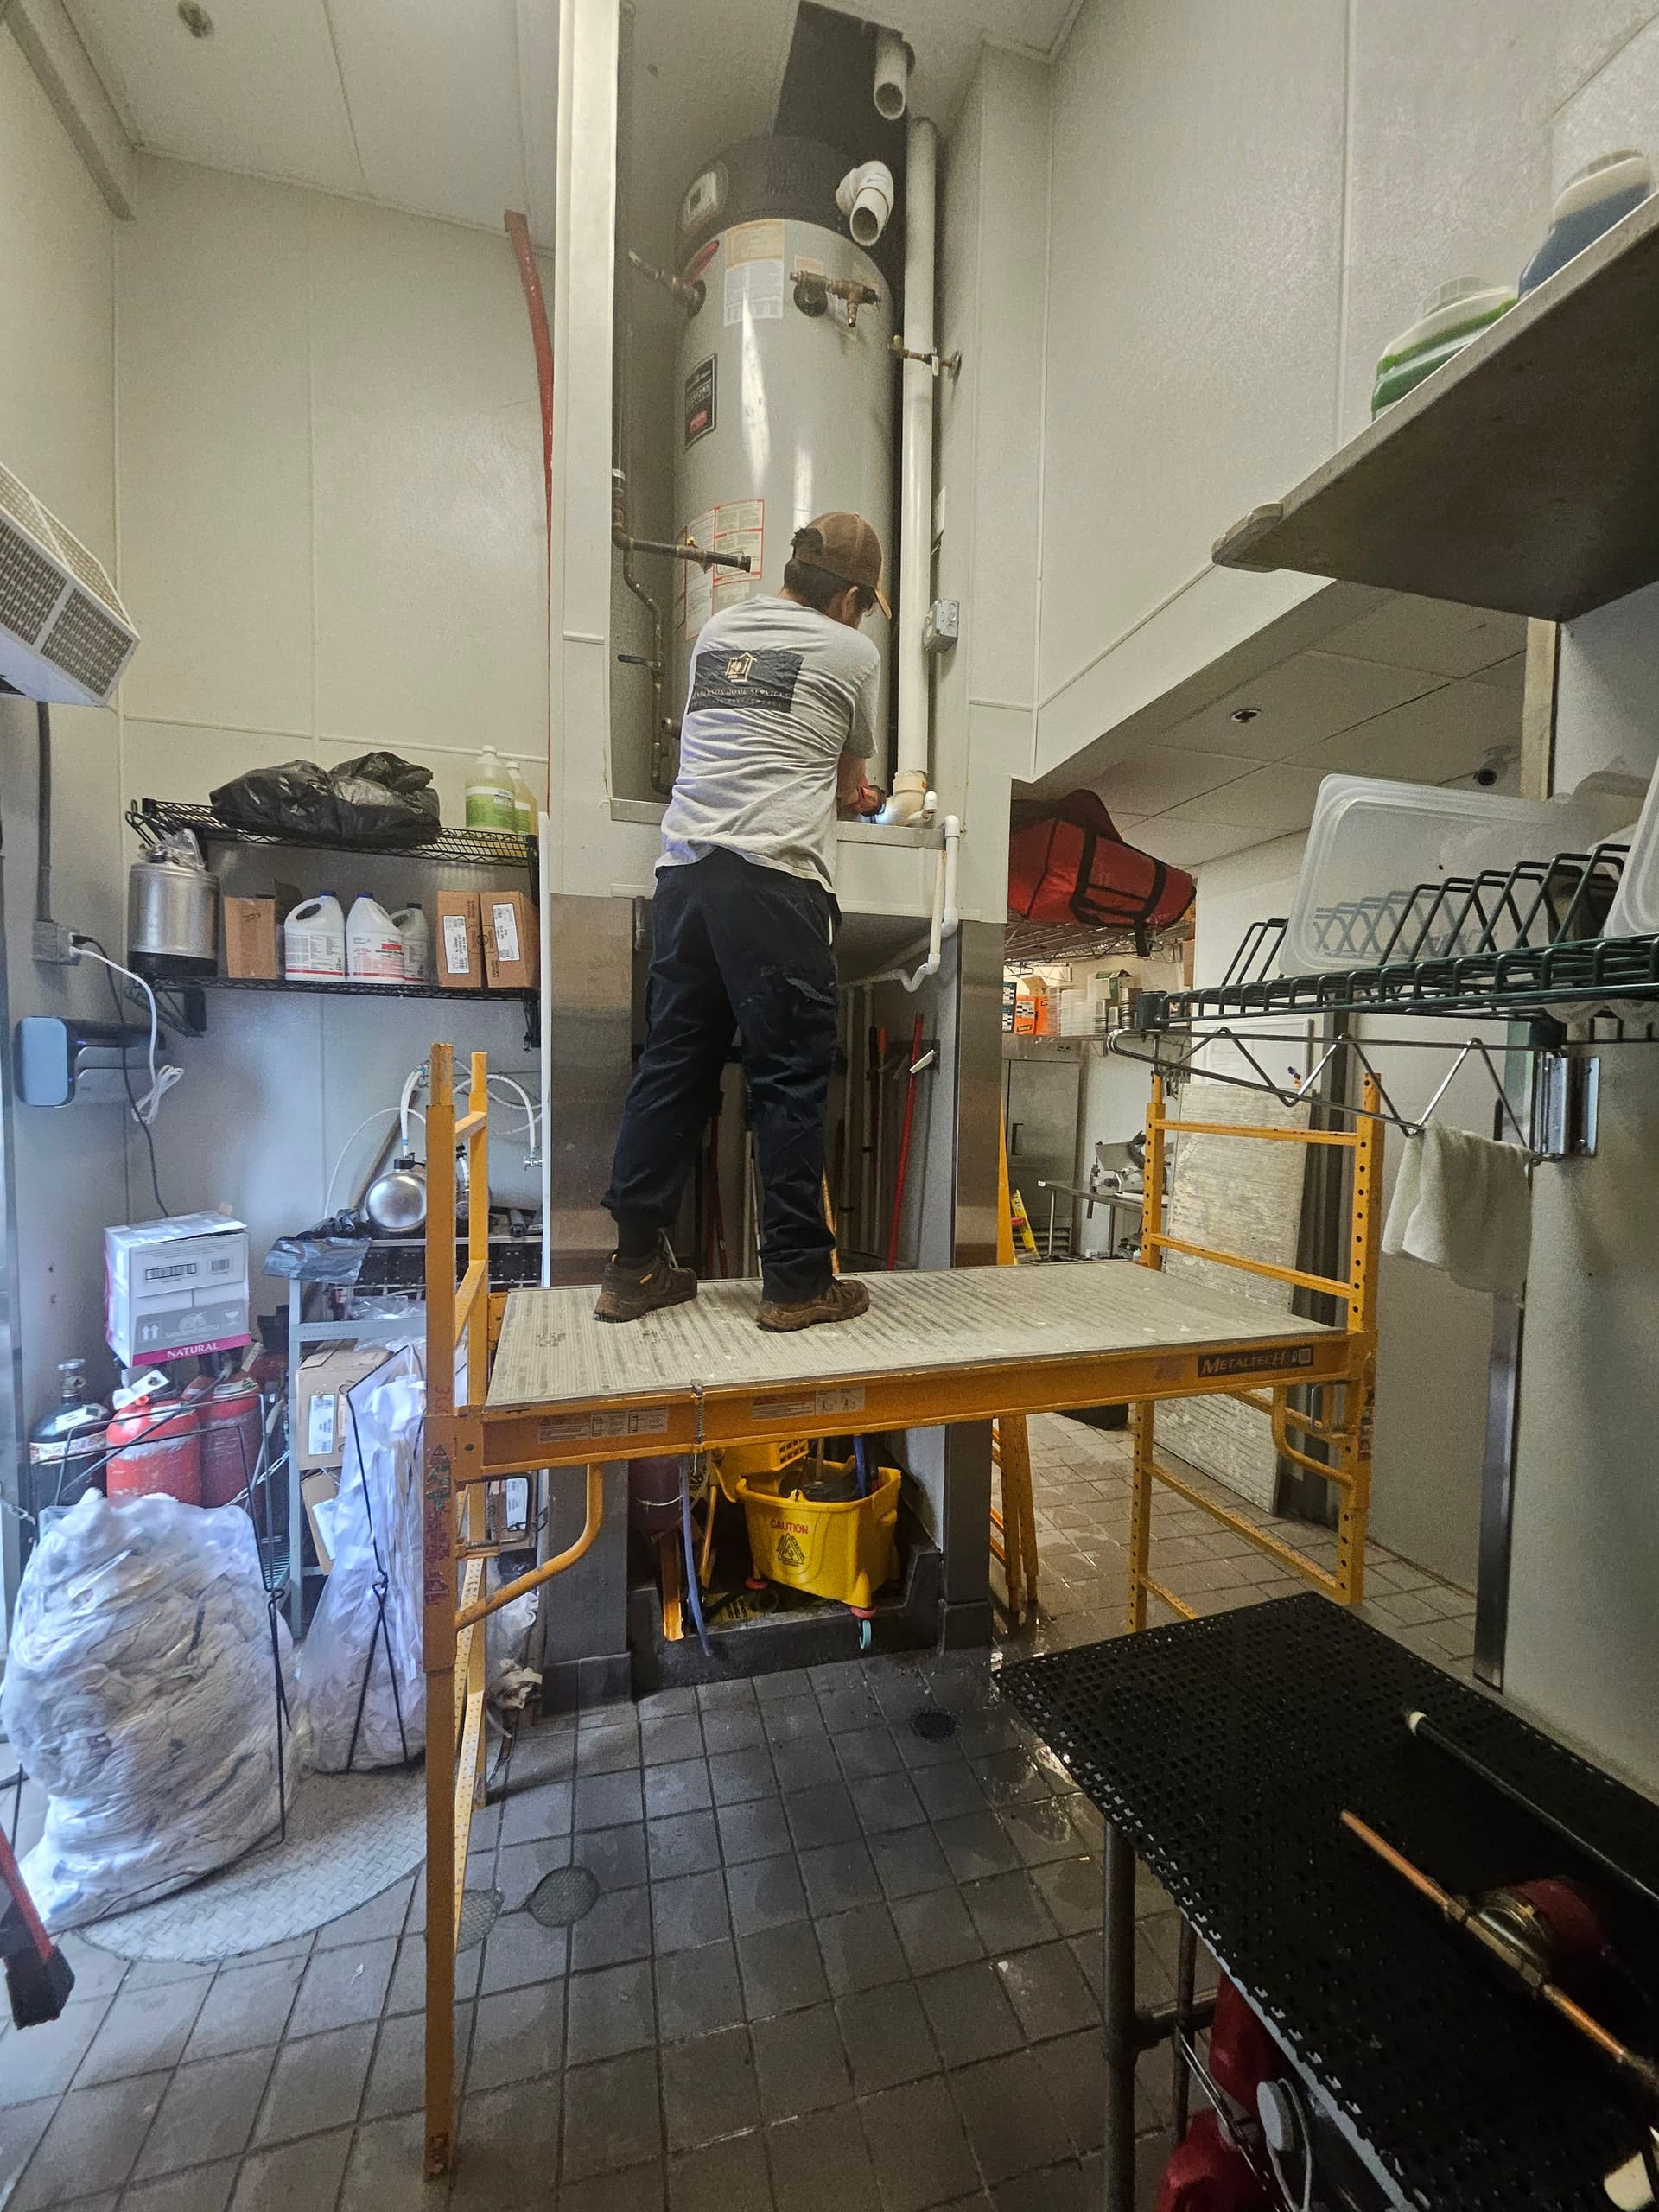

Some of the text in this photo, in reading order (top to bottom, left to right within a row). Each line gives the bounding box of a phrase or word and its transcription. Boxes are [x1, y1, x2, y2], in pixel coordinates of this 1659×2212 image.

[166, 1342, 219, 1358] NATURAL
[1202, 1351, 1286, 1374] METALTECH
[770, 1519, 809, 1535] CAUTION
